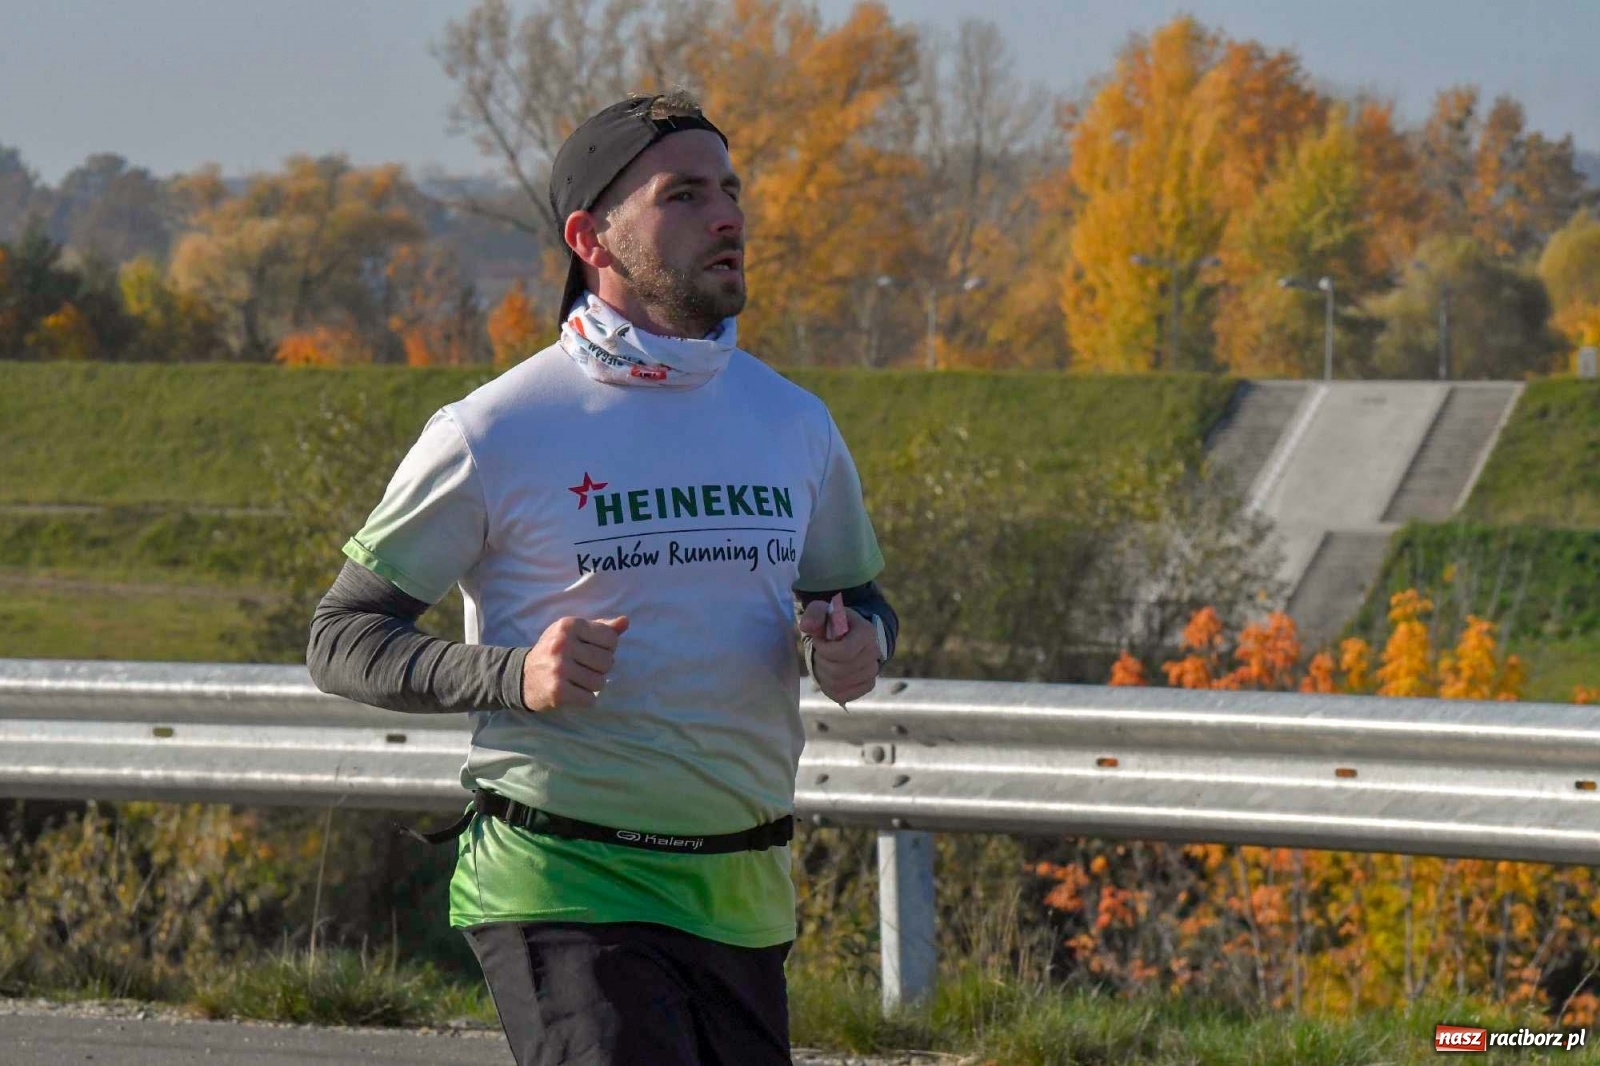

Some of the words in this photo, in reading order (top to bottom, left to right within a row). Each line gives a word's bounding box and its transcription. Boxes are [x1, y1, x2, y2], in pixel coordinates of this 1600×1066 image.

[594, 485, 794, 526] HEINEKEN
[577, 540, 660, 575] Kraków
[669, 538, 758, 571] Running
[767, 537, 796, 565] Club
[645, 834, 704, 850] Kalenji
